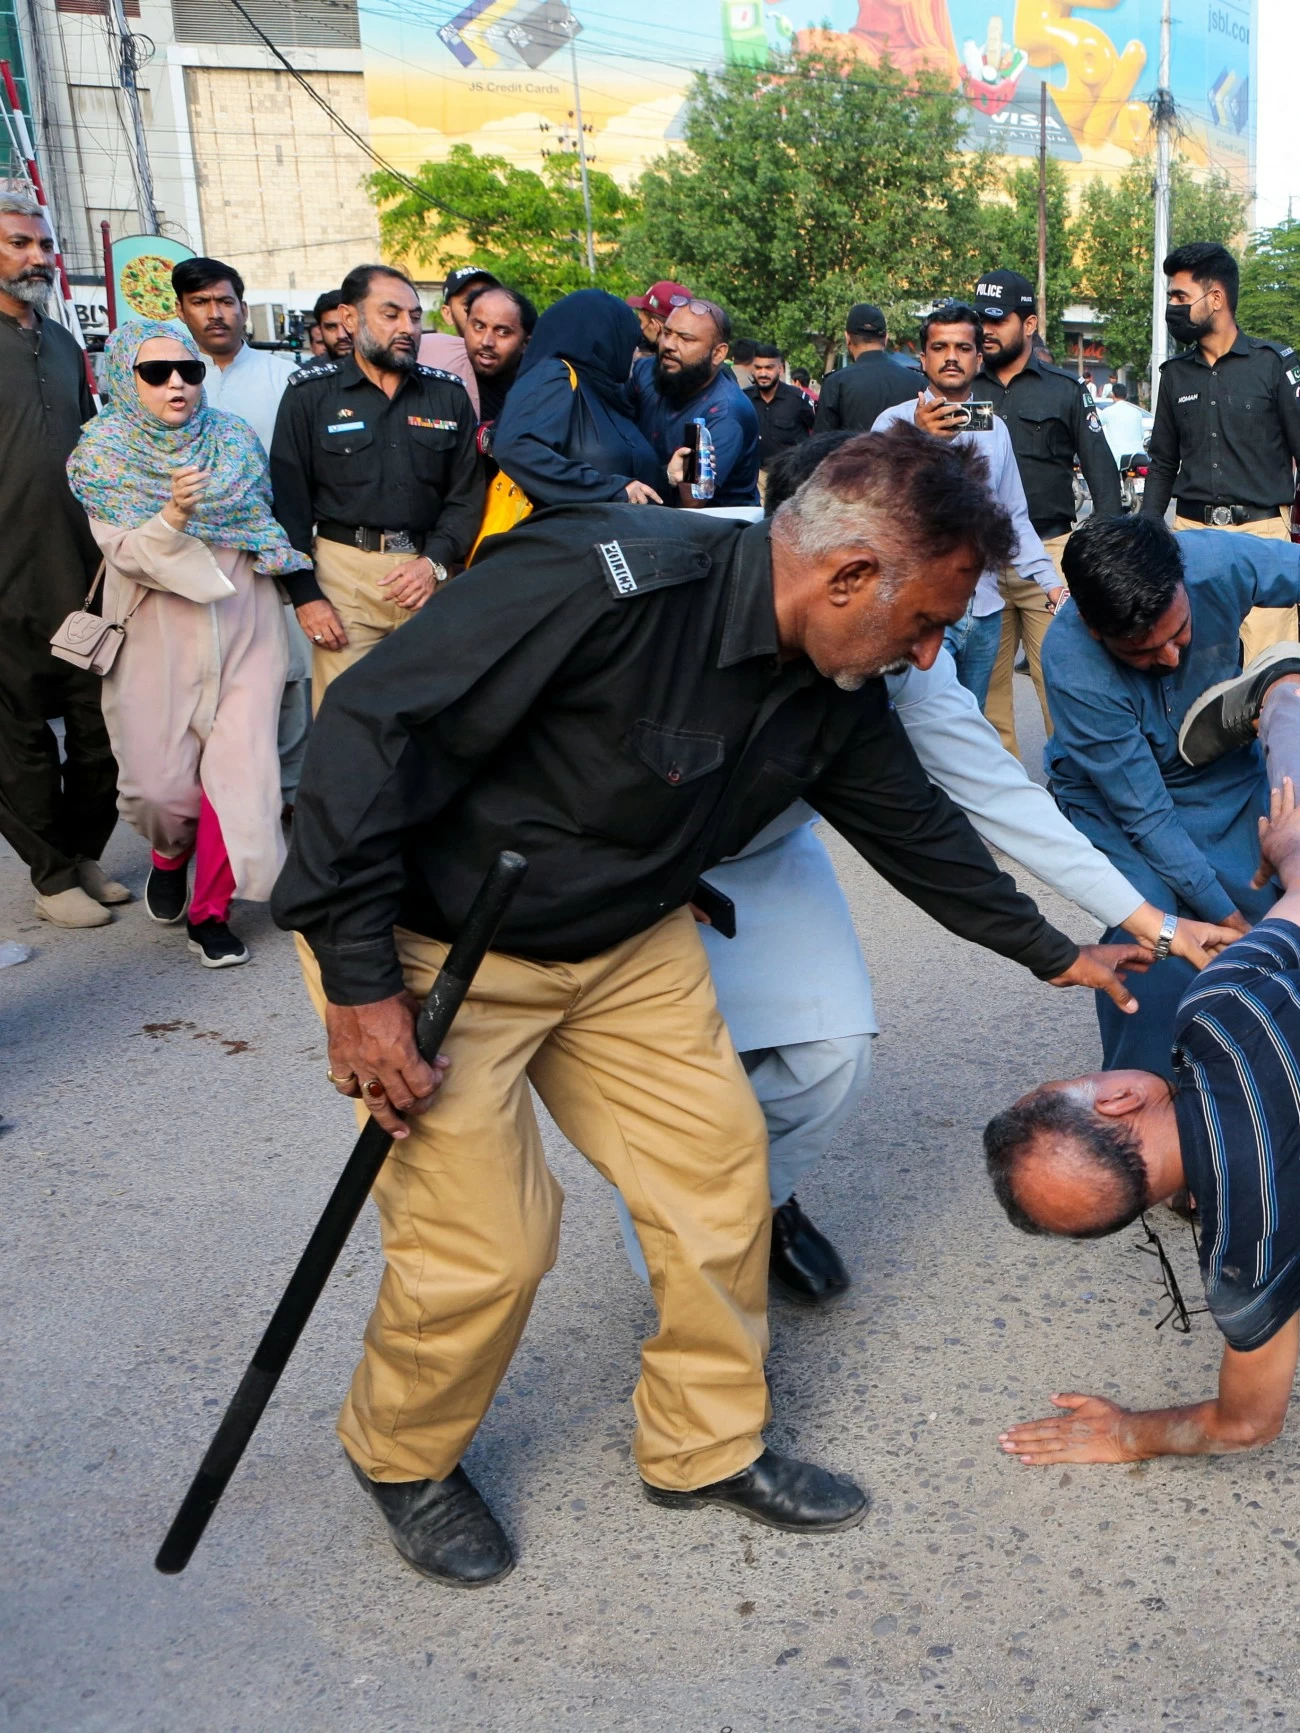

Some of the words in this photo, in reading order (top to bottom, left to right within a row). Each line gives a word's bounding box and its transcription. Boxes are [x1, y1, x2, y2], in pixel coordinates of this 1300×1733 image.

[468, 82, 483, 93] JS
[487, 82, 522, 93] Credit
[526, 83, 560, 94] Cards
[991, 111, 1062, 129] VISA
[976, 283, 1003, 298] POLICE
[600, 540, 638, 594] POLICE
